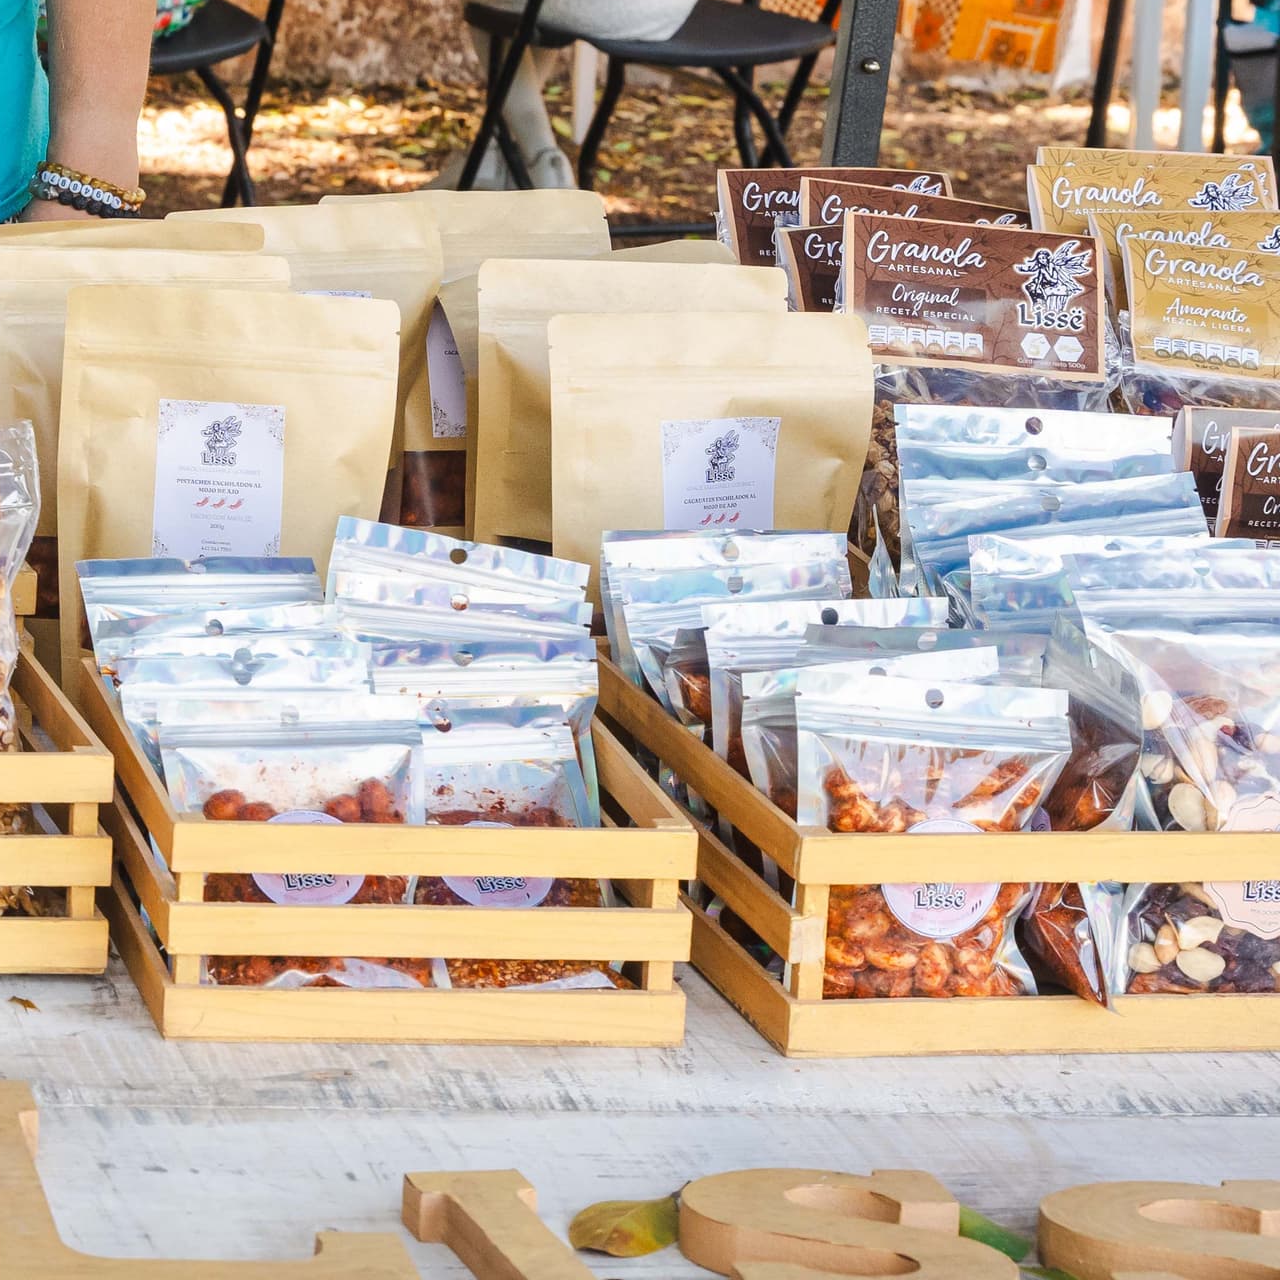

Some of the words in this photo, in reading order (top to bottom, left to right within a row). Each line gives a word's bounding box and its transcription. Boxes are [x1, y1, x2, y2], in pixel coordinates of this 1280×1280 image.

[1052, 176, 1163, 209] Granola
[1116, 221, 1231, 248] Granola
[867, 230, 987, 268] Granola
[888, 263, 961, 278] ARTESANAL
[1145, 248, 1265, 287] Granola
[892, 283, 960, 311] Original
[1168, 277, 1241, 294] ARTESANAL
[876, 306, 919, 318] RECETA
[923, 310, 976, 322] ESPECIAL
[1018, 303, 1083, 330] Lissë
[1166, 297, 1248, 324] Amaranto
[1162, 316, 1207, 328] MEZCLA
[1211, 323, 1252, 334] LIGERA
[914, 889, 965, 910] Lissë
